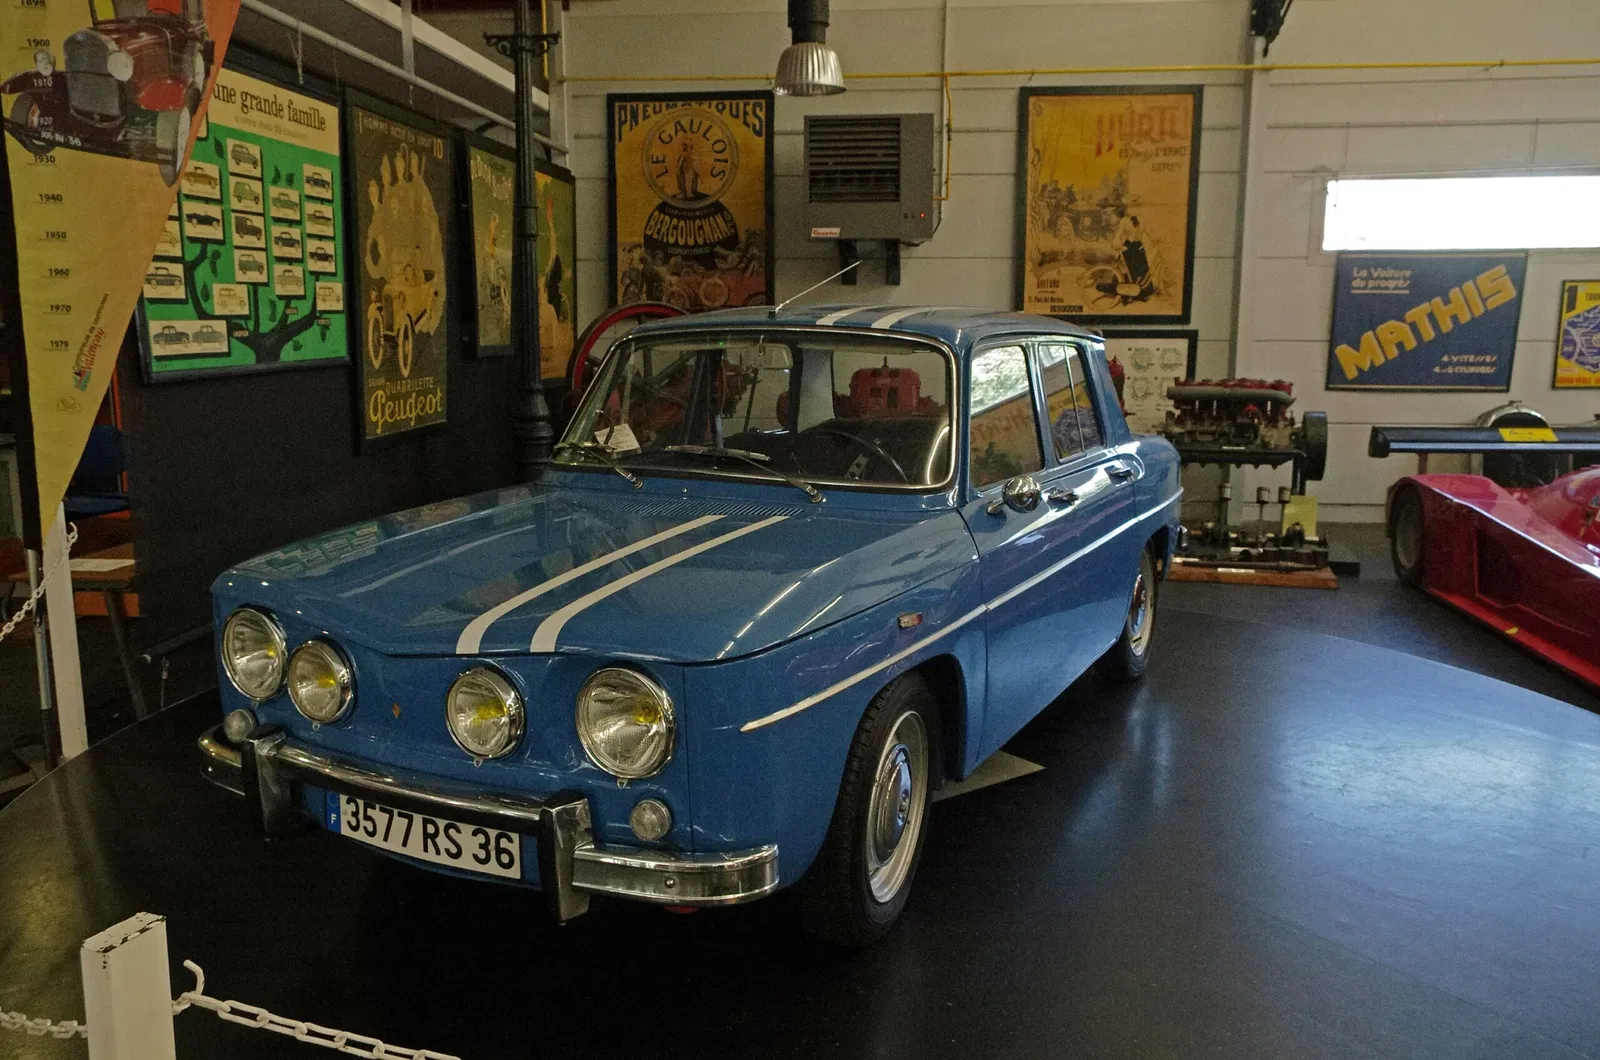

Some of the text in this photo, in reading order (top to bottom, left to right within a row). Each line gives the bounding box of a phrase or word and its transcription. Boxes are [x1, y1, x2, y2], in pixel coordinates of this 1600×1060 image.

[27, 38, 50, 47] 1900
[33, 79, 53, 88] 1910
[213, 83, 236, 104] une
[240, 90, 284, 118] grande
[287, 99, 326, 131] famille
[433, 138, 443, 159] 10
[651, 118, 734, 180] LE GAULOIS
[34, 154, 56, 163] 1930
[39, 193, 63, 202] 1940
[645, 209, 731, 246] BERGOUGNAN
[46, 231, 67, 239] 1950
[49, 268, 70, 276] 1960
[1352, 265, 1413, 279] La Voiture
[50, 304, 71, 312] 1970
[1335, 263, 1517, 381] MATHIS
[50, 340, 69, 348] 1979
[385, 376, 434, 396] QUADRILETTE
[369, 387, 443, 434] Peugeot
[330, 813, 337, 824] F
[346, 797, 515, 870] 3577 RS 36
